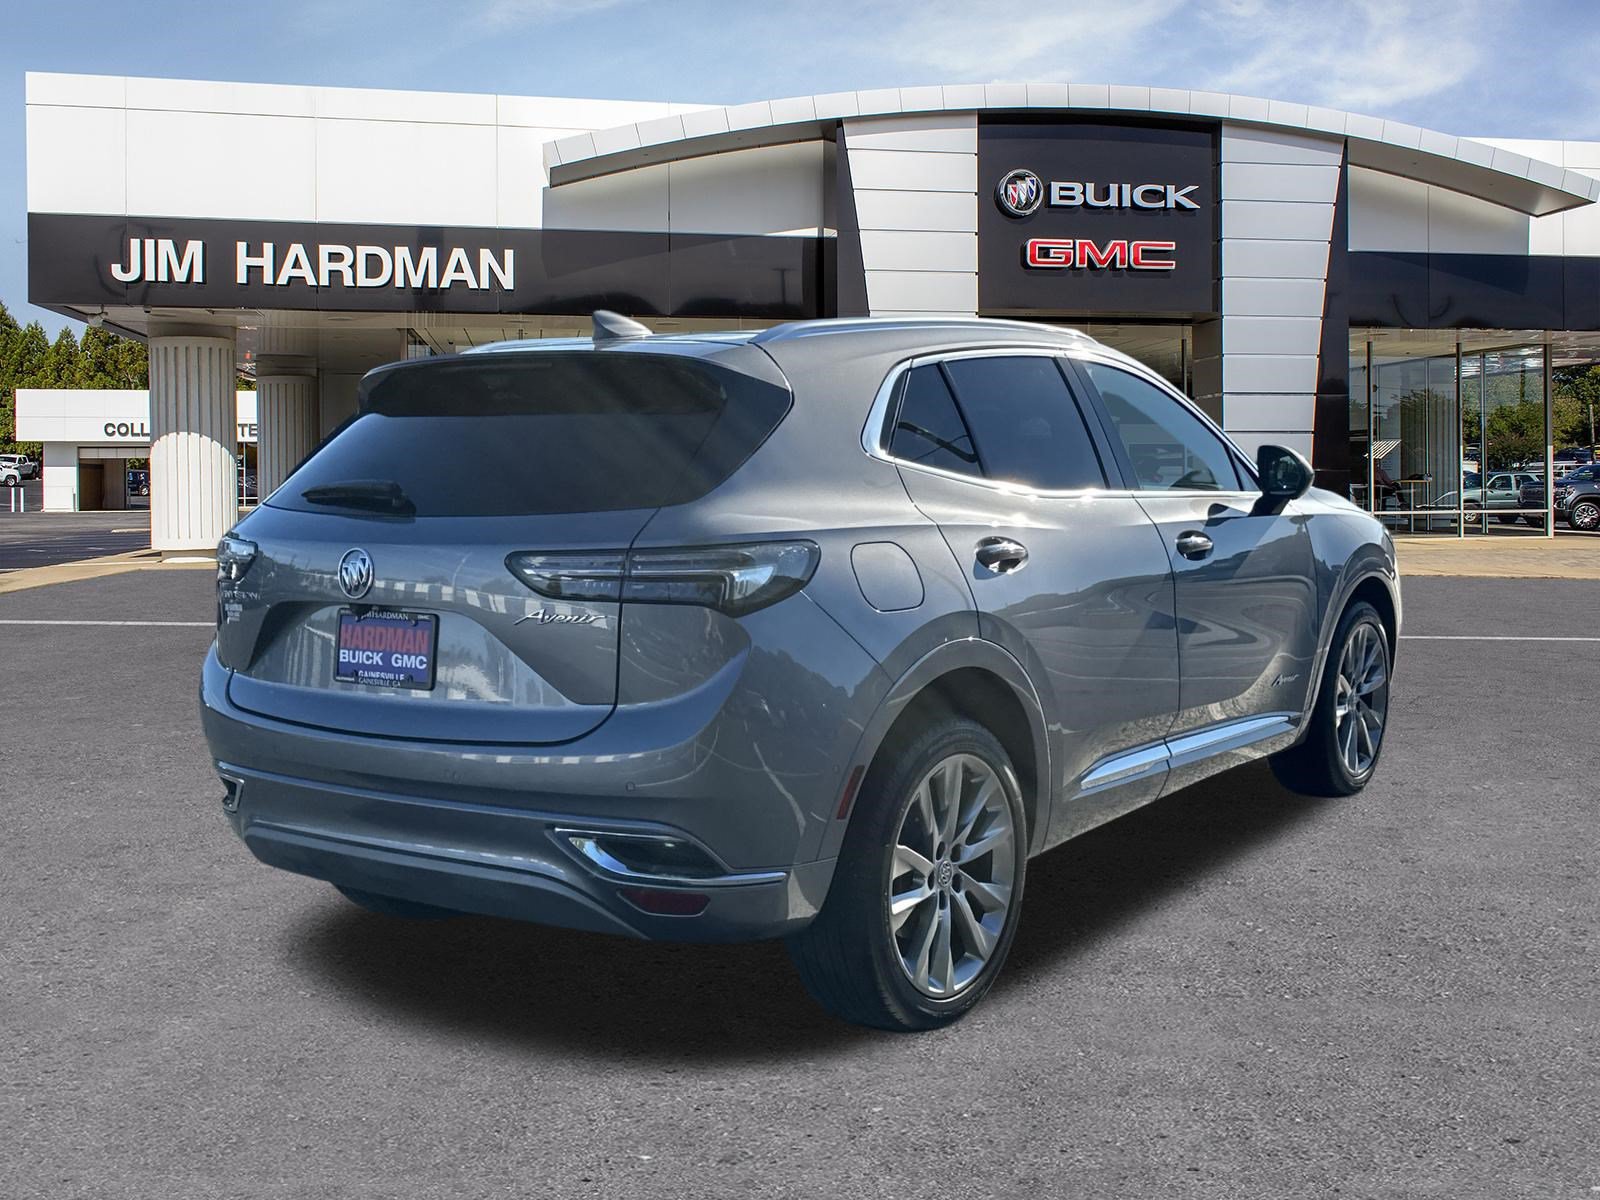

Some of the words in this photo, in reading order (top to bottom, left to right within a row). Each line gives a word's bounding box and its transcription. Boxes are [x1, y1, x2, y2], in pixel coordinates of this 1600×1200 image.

[1050, 181, 1201, 209] BUICK
[110, 238, 204, 284] JIM
[235, 240, 515, 291] HARDMAN
[1026, 238, 1176, 270] GMC
[513, 608, 607, 626] Avenir
[340, 624, 430, 654] HARDMAN
[339, 649, 384, 666] BUICK
[391, 653, 428, 670] GMC
